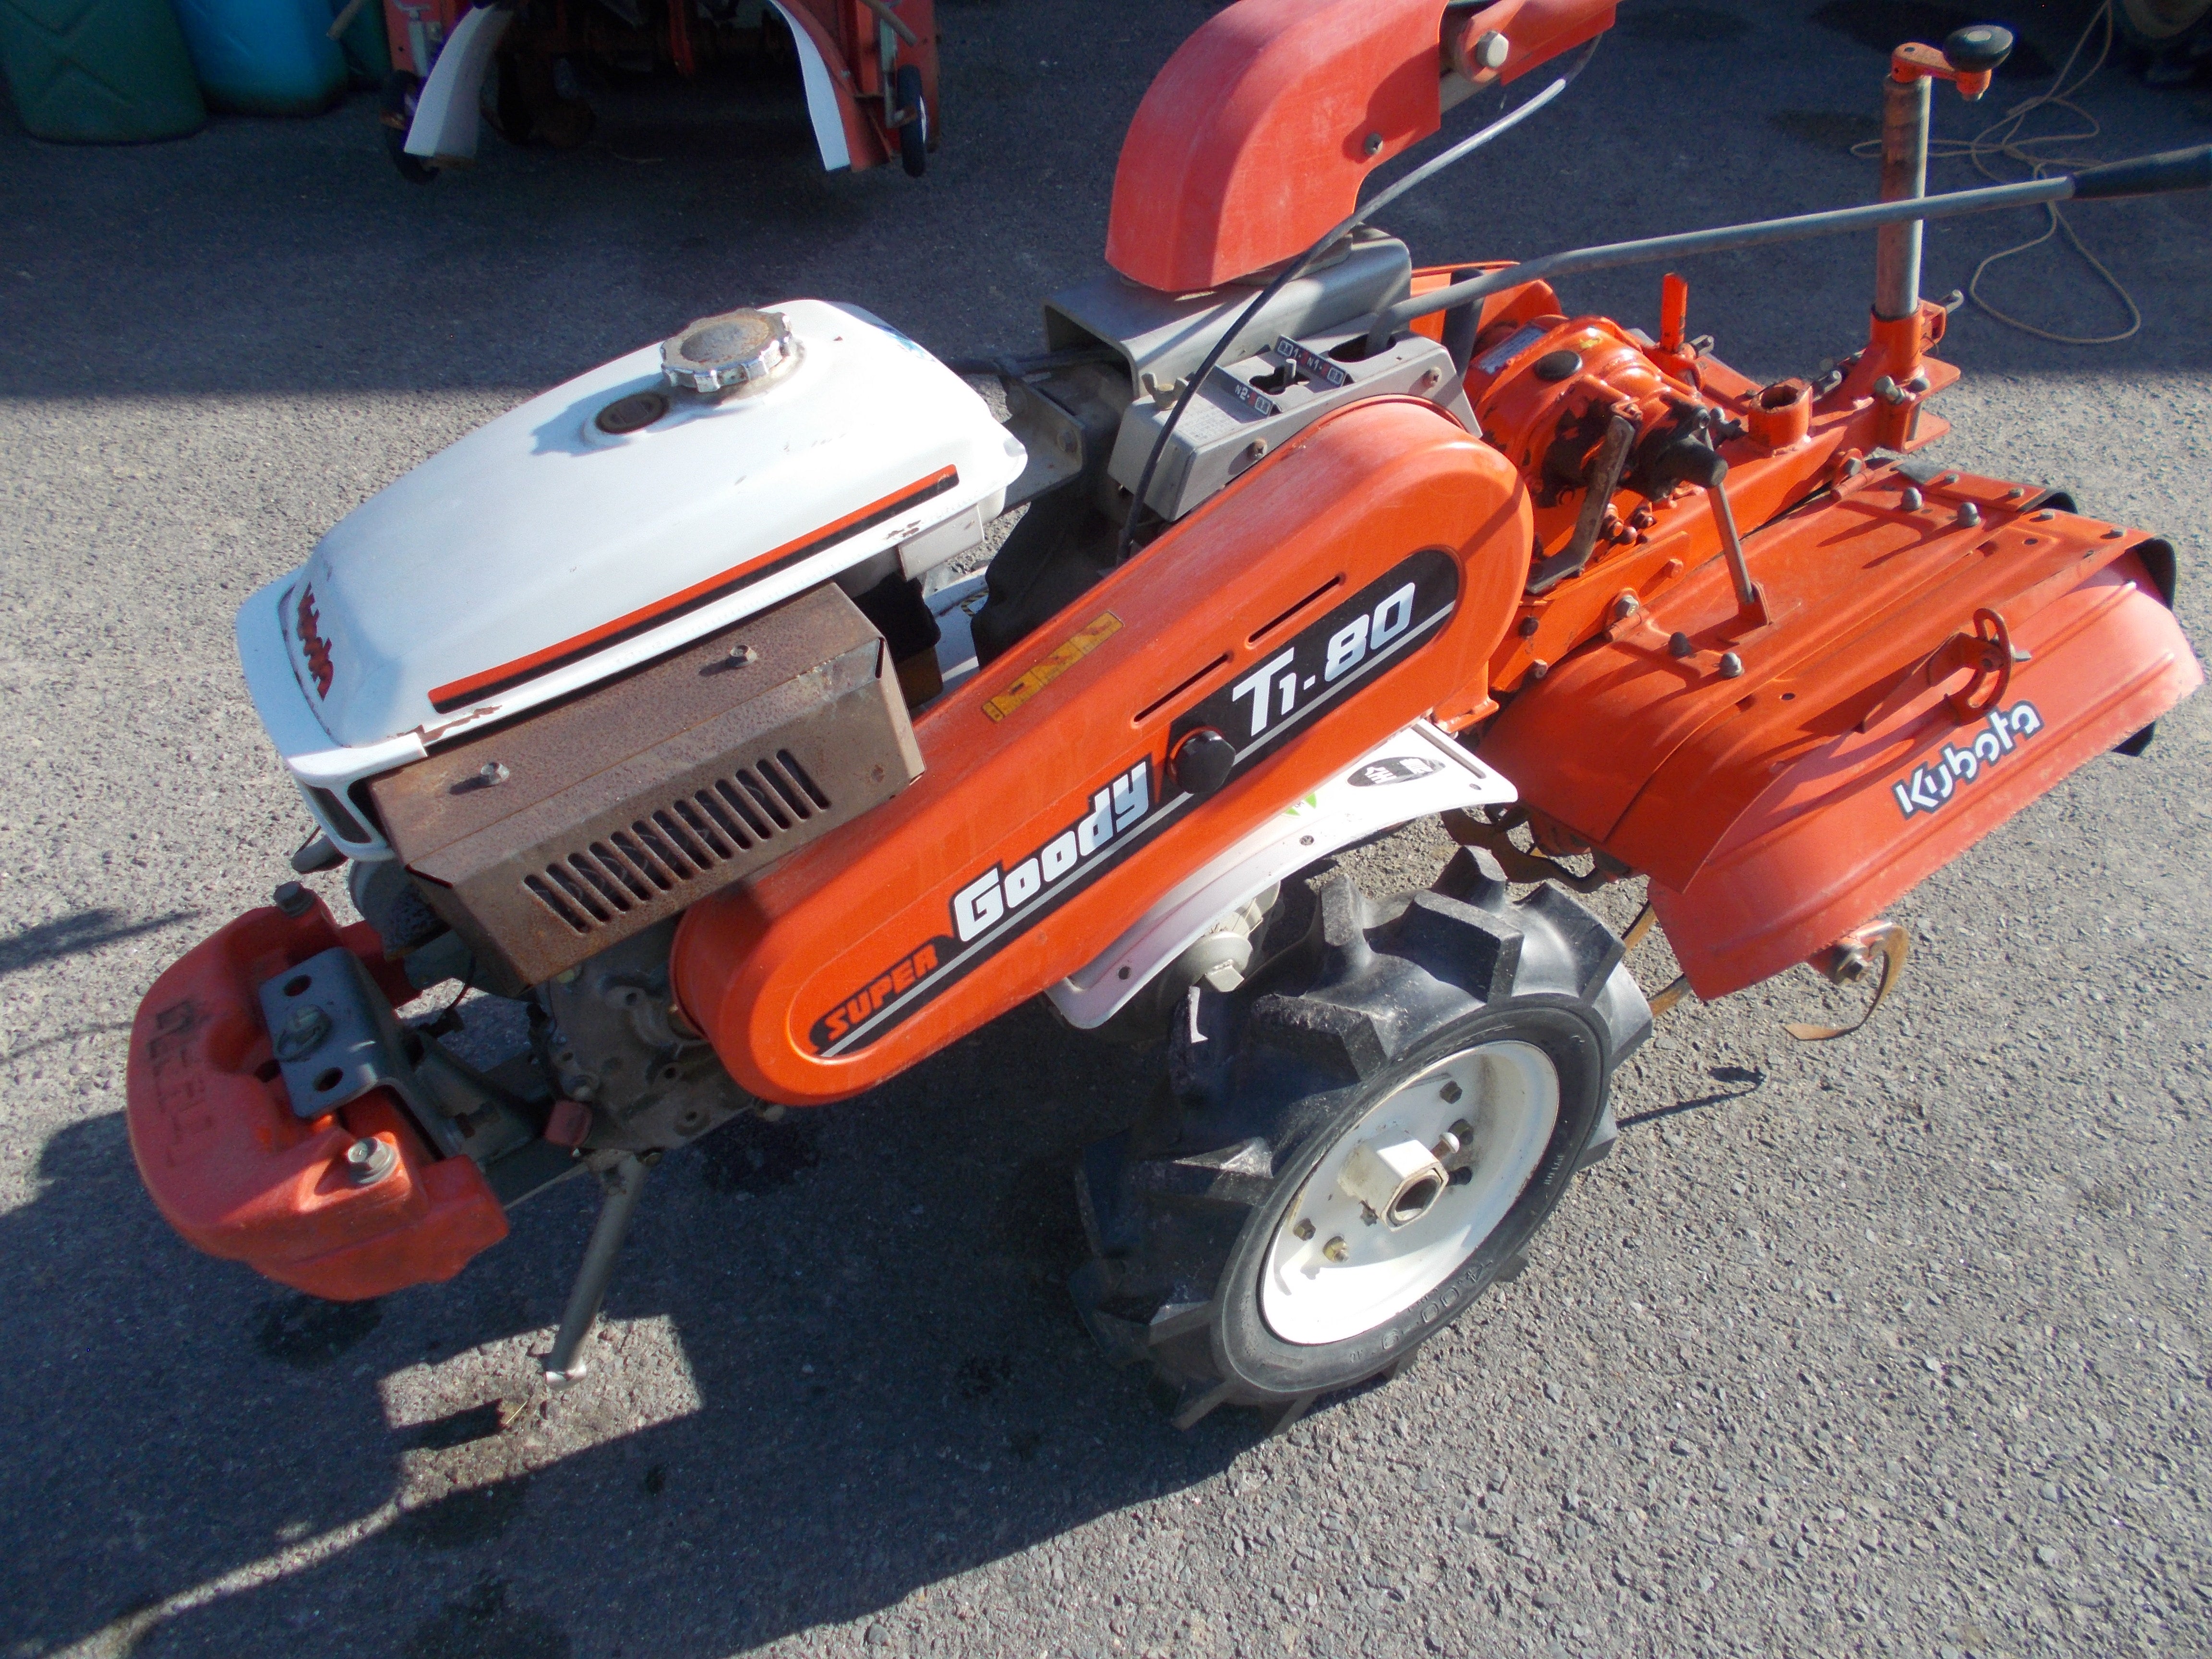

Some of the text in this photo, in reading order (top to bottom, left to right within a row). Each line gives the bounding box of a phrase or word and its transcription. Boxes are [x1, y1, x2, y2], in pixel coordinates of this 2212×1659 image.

[1894, 703, 2042, 815] Kubota
[825, 944, 938, 1042] SUPER
[954, 761, 1149, 942] Goody
